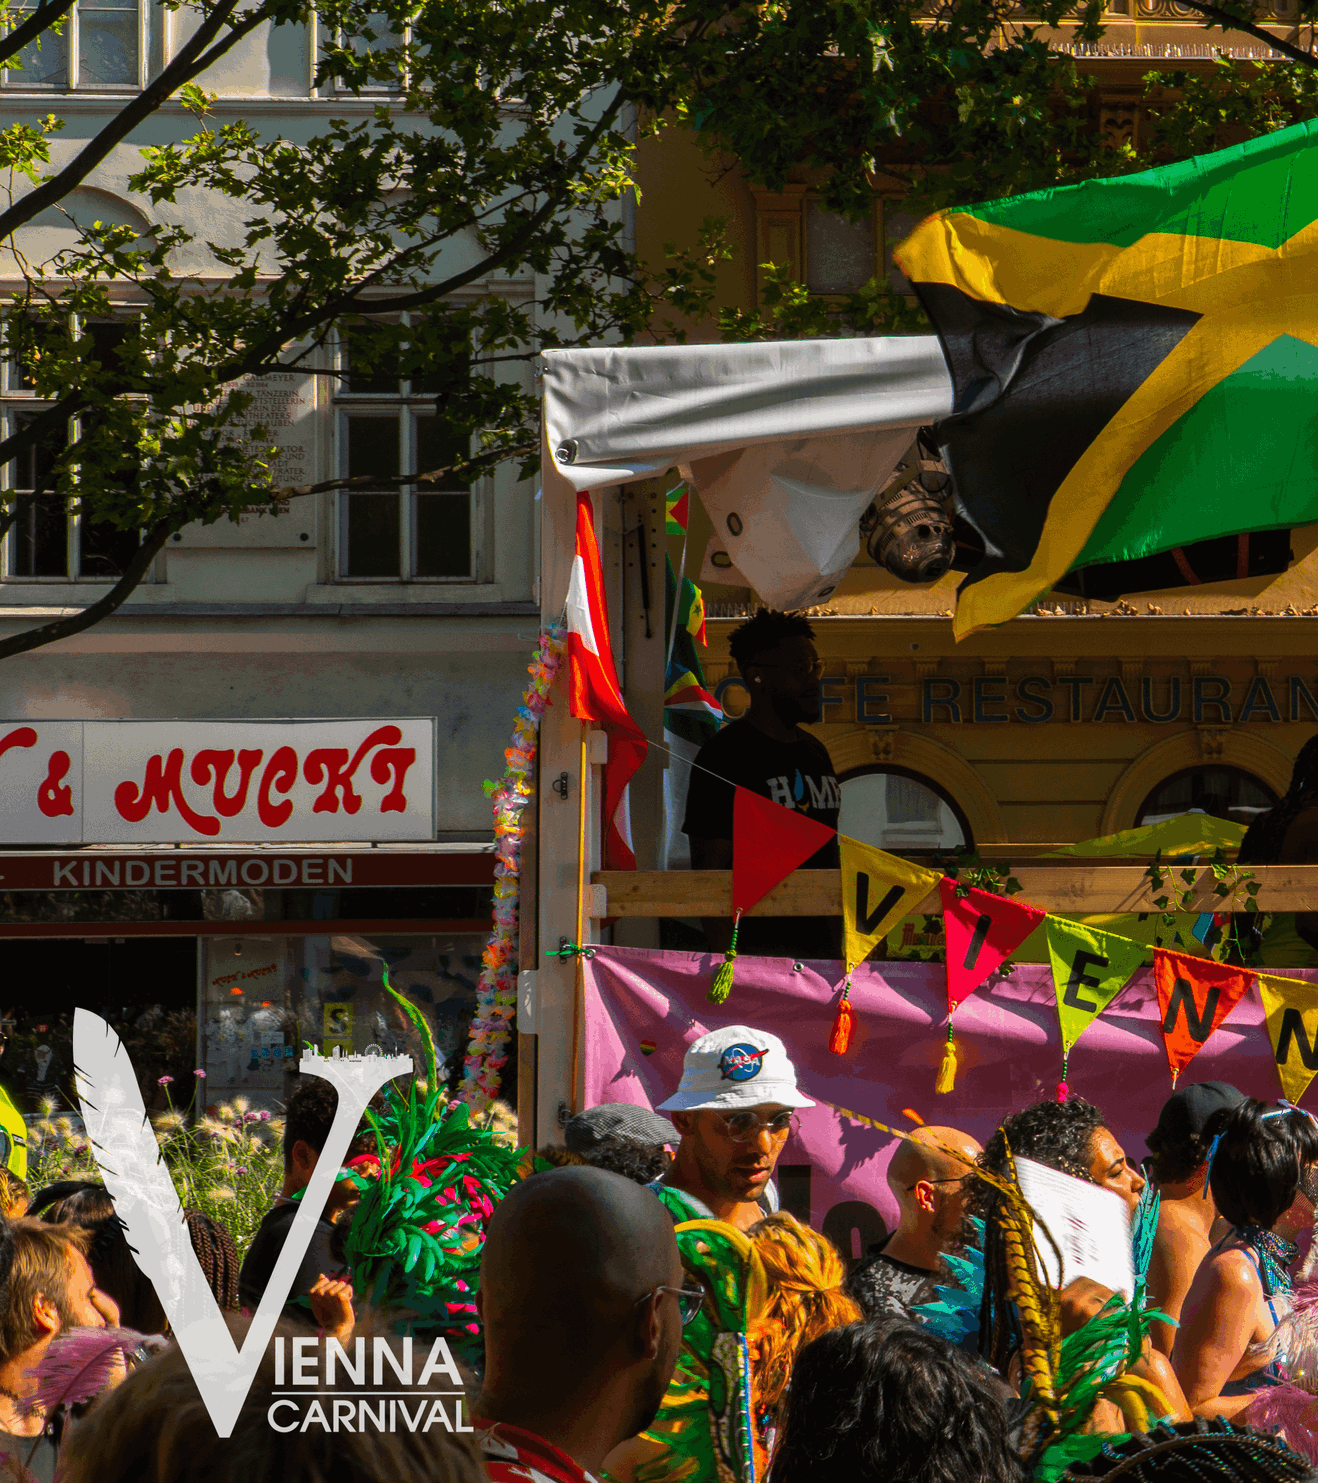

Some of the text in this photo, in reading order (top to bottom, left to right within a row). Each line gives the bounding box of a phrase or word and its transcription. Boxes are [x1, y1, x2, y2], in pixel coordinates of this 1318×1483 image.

[714, 676, 891, 725] CFE
[37, 725, 417, 836] & MUCKI
[52, 857, 354, 888] KINDERMODEN
